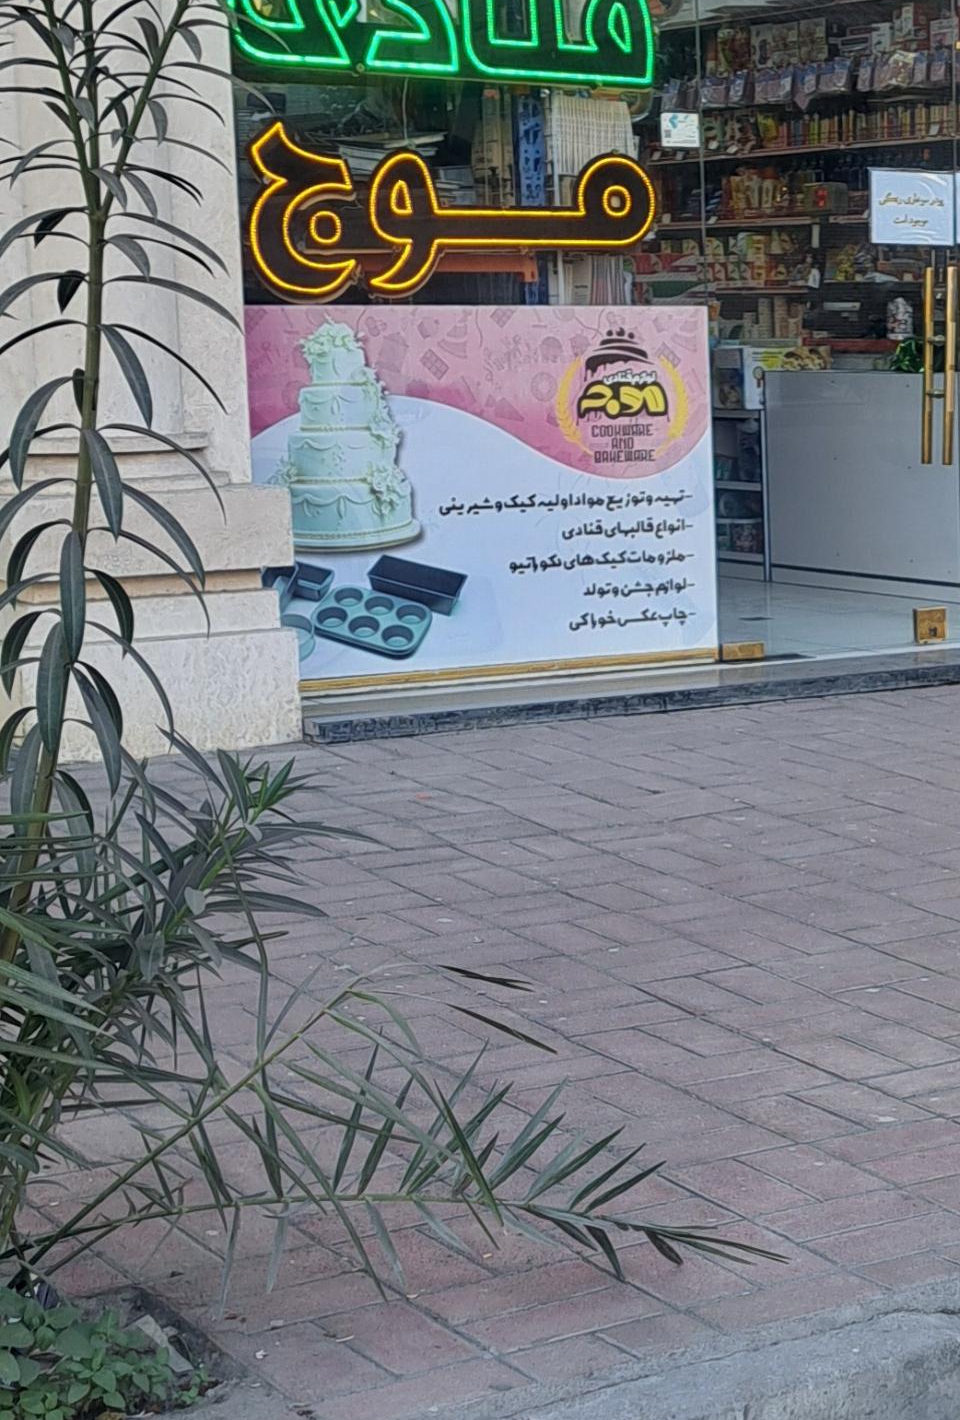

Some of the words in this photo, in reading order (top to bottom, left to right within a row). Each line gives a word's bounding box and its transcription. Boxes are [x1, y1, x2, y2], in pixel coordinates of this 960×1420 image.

[248, 120, 656, 296] موج
[611, 437, 634, 450] AND
[562, 519, 604, 540] قنادی
[583, 583, 613, 598] تولد
